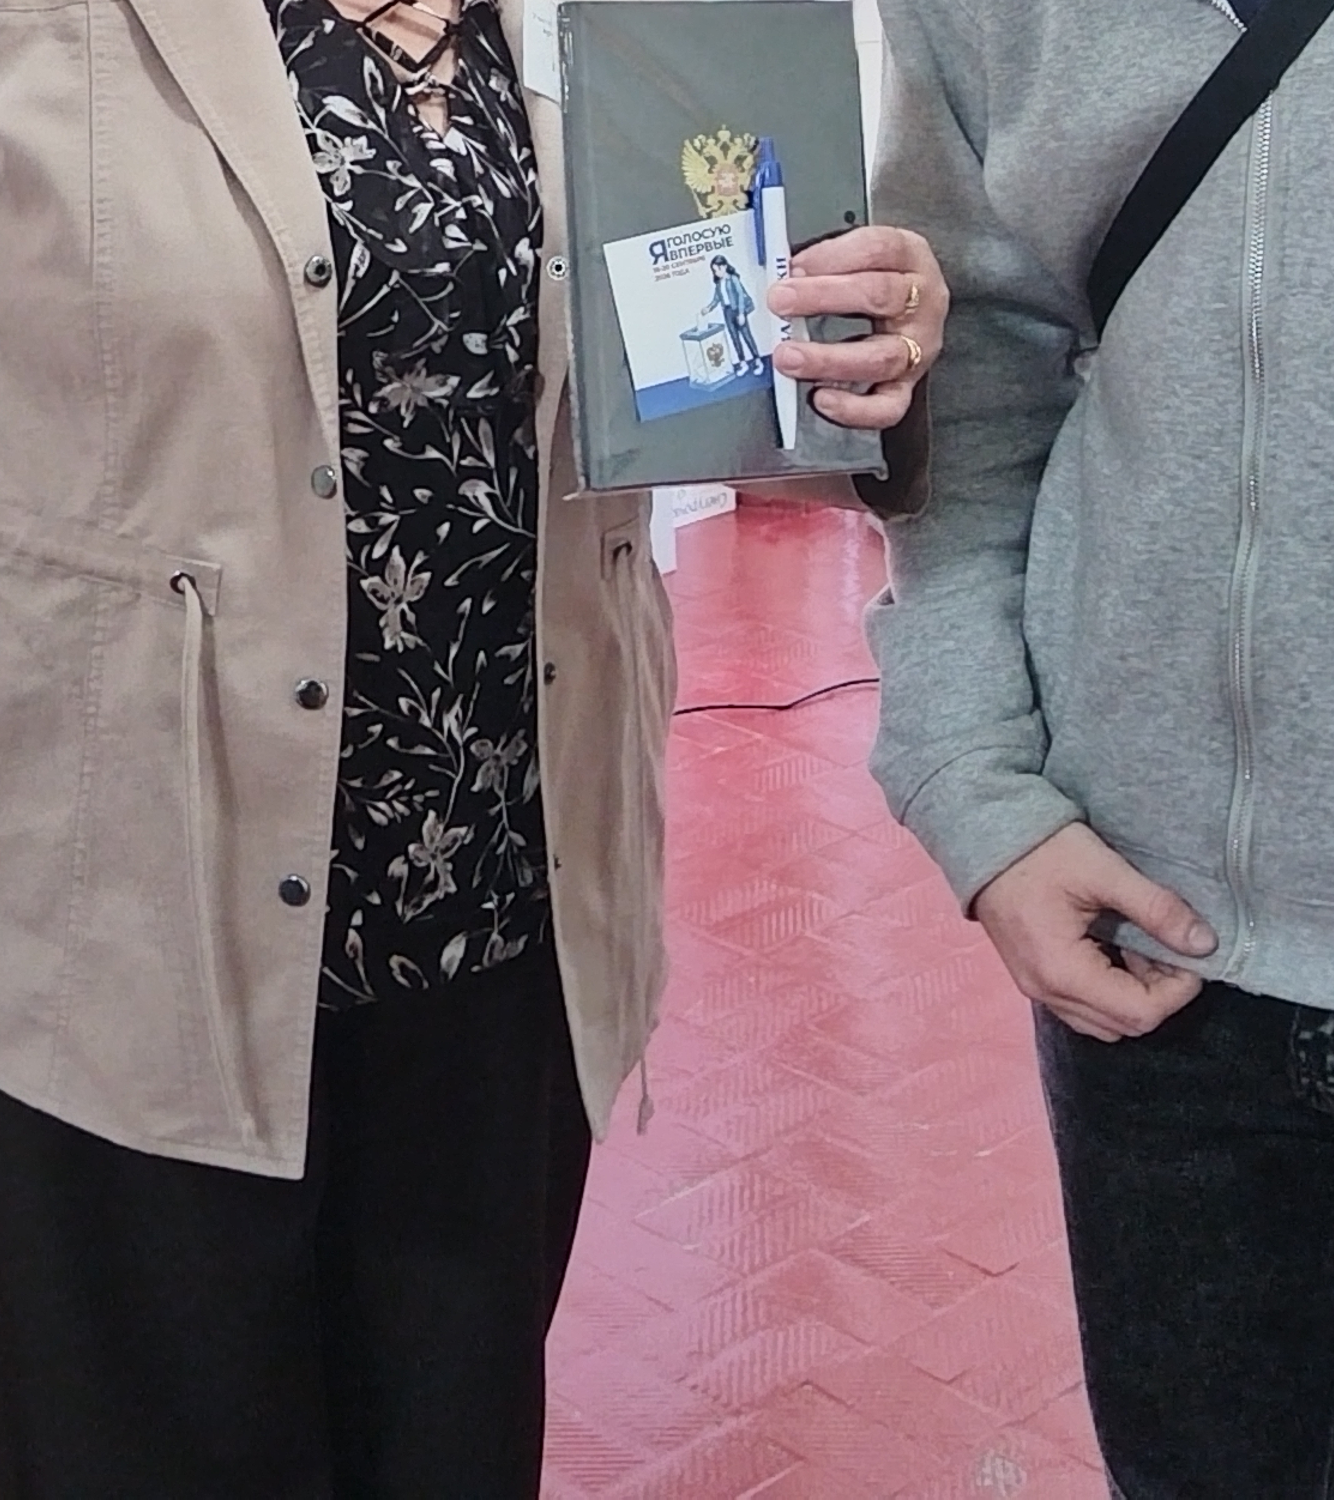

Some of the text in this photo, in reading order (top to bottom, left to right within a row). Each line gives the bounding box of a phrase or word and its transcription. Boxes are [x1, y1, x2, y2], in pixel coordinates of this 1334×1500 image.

[649, 224, 731, 266] Я ГОЛОСУЮ
[669, 236, 734, 262] ВПЕРВЫЕ
